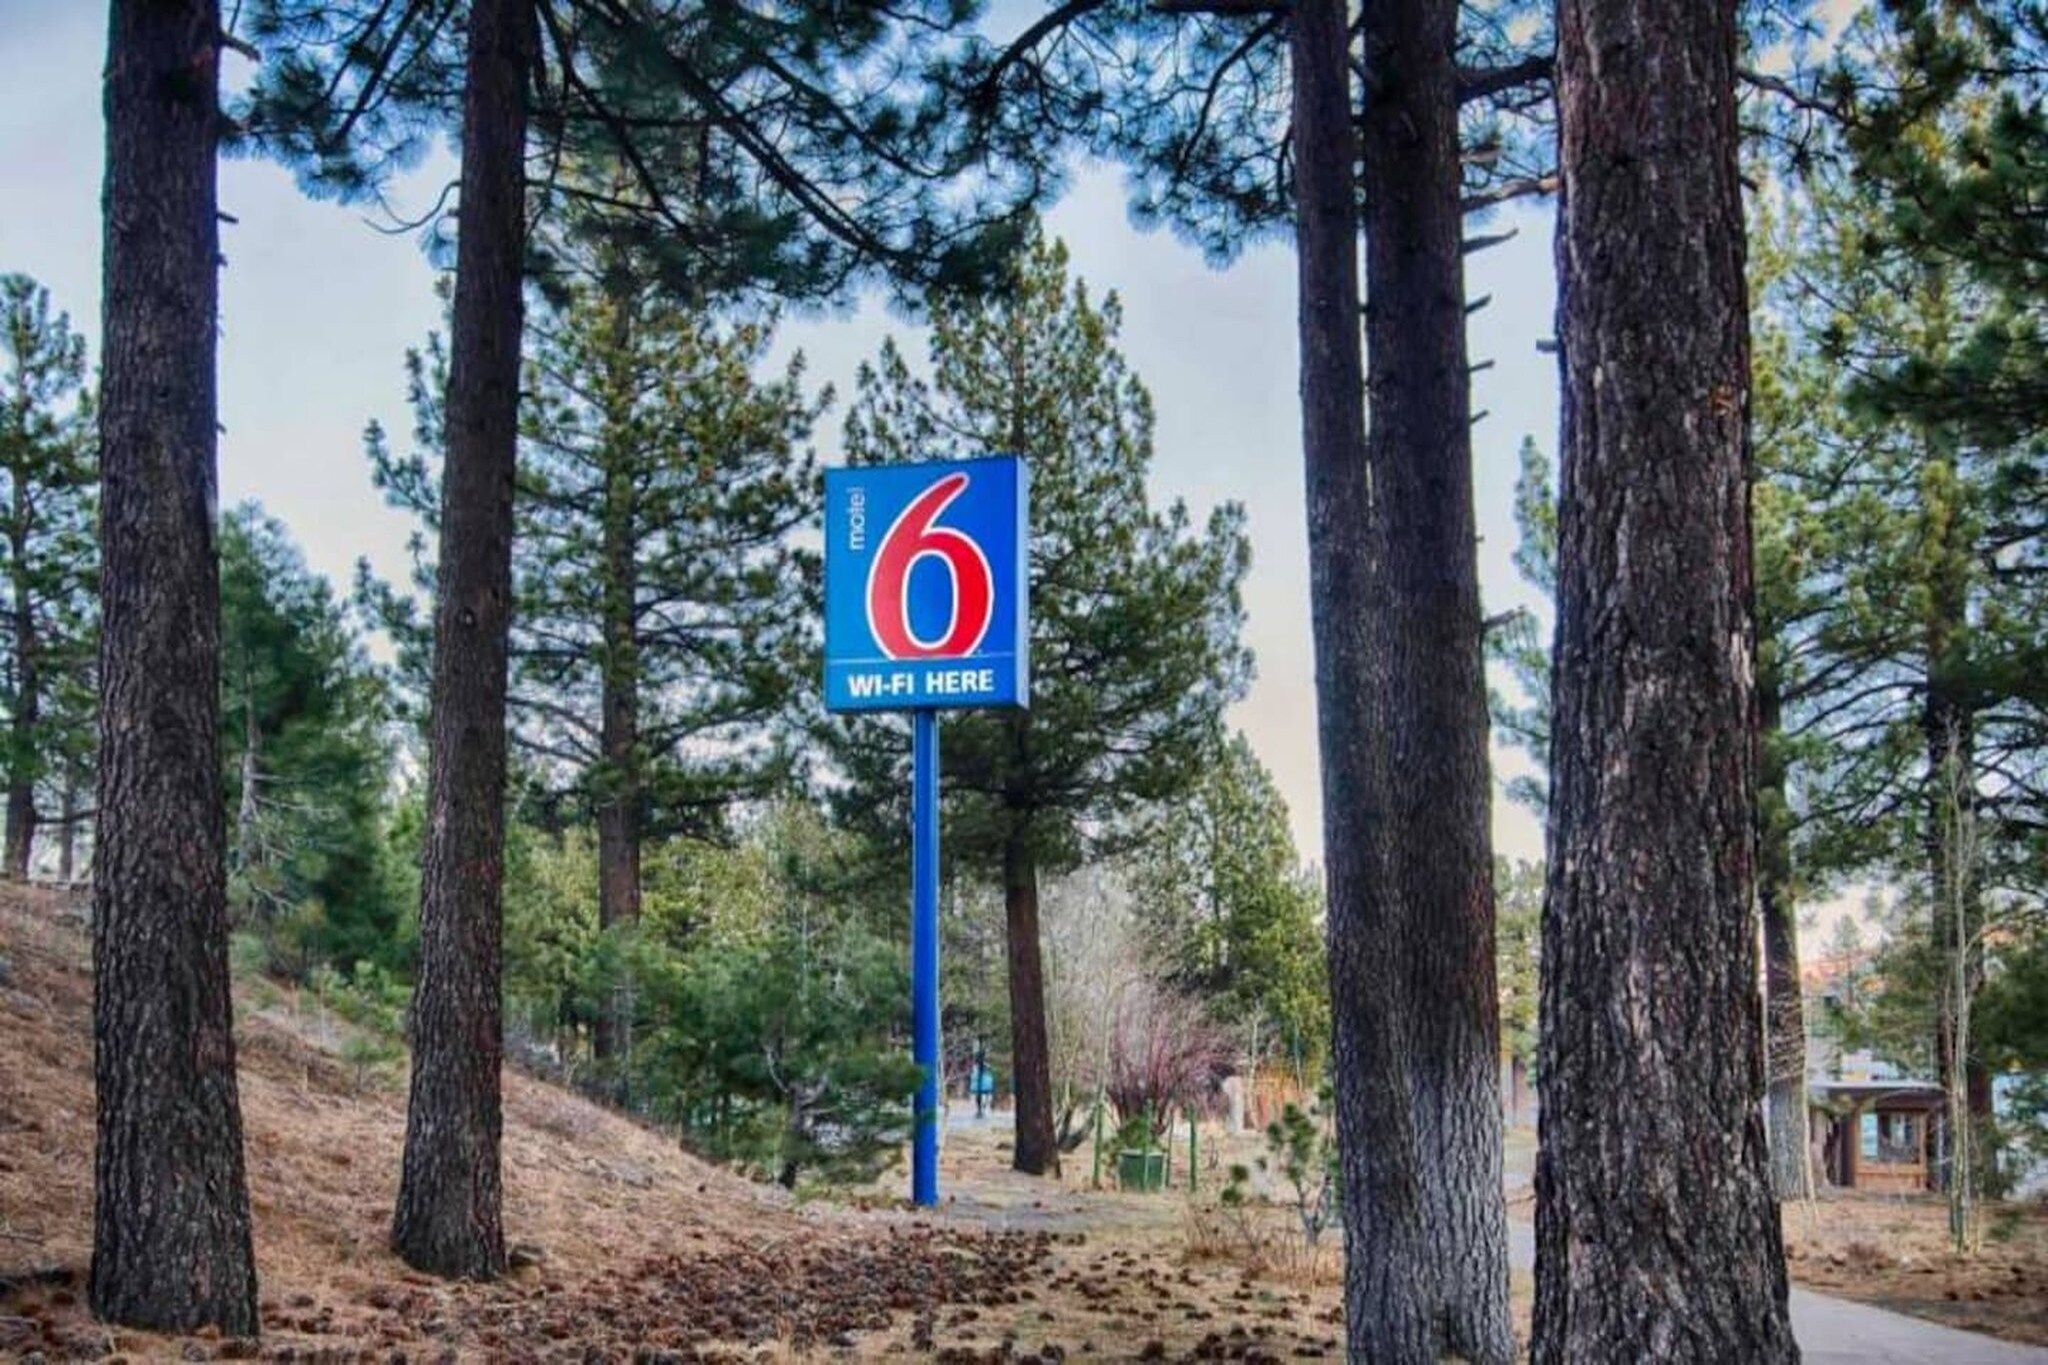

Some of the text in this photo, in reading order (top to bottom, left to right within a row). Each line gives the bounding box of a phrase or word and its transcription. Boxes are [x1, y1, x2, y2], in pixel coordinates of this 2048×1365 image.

[847, 487, 865, 551] motel
[866, 472, 994, 661] 6
[848, 669, 994, 697] WI-FI HERE
